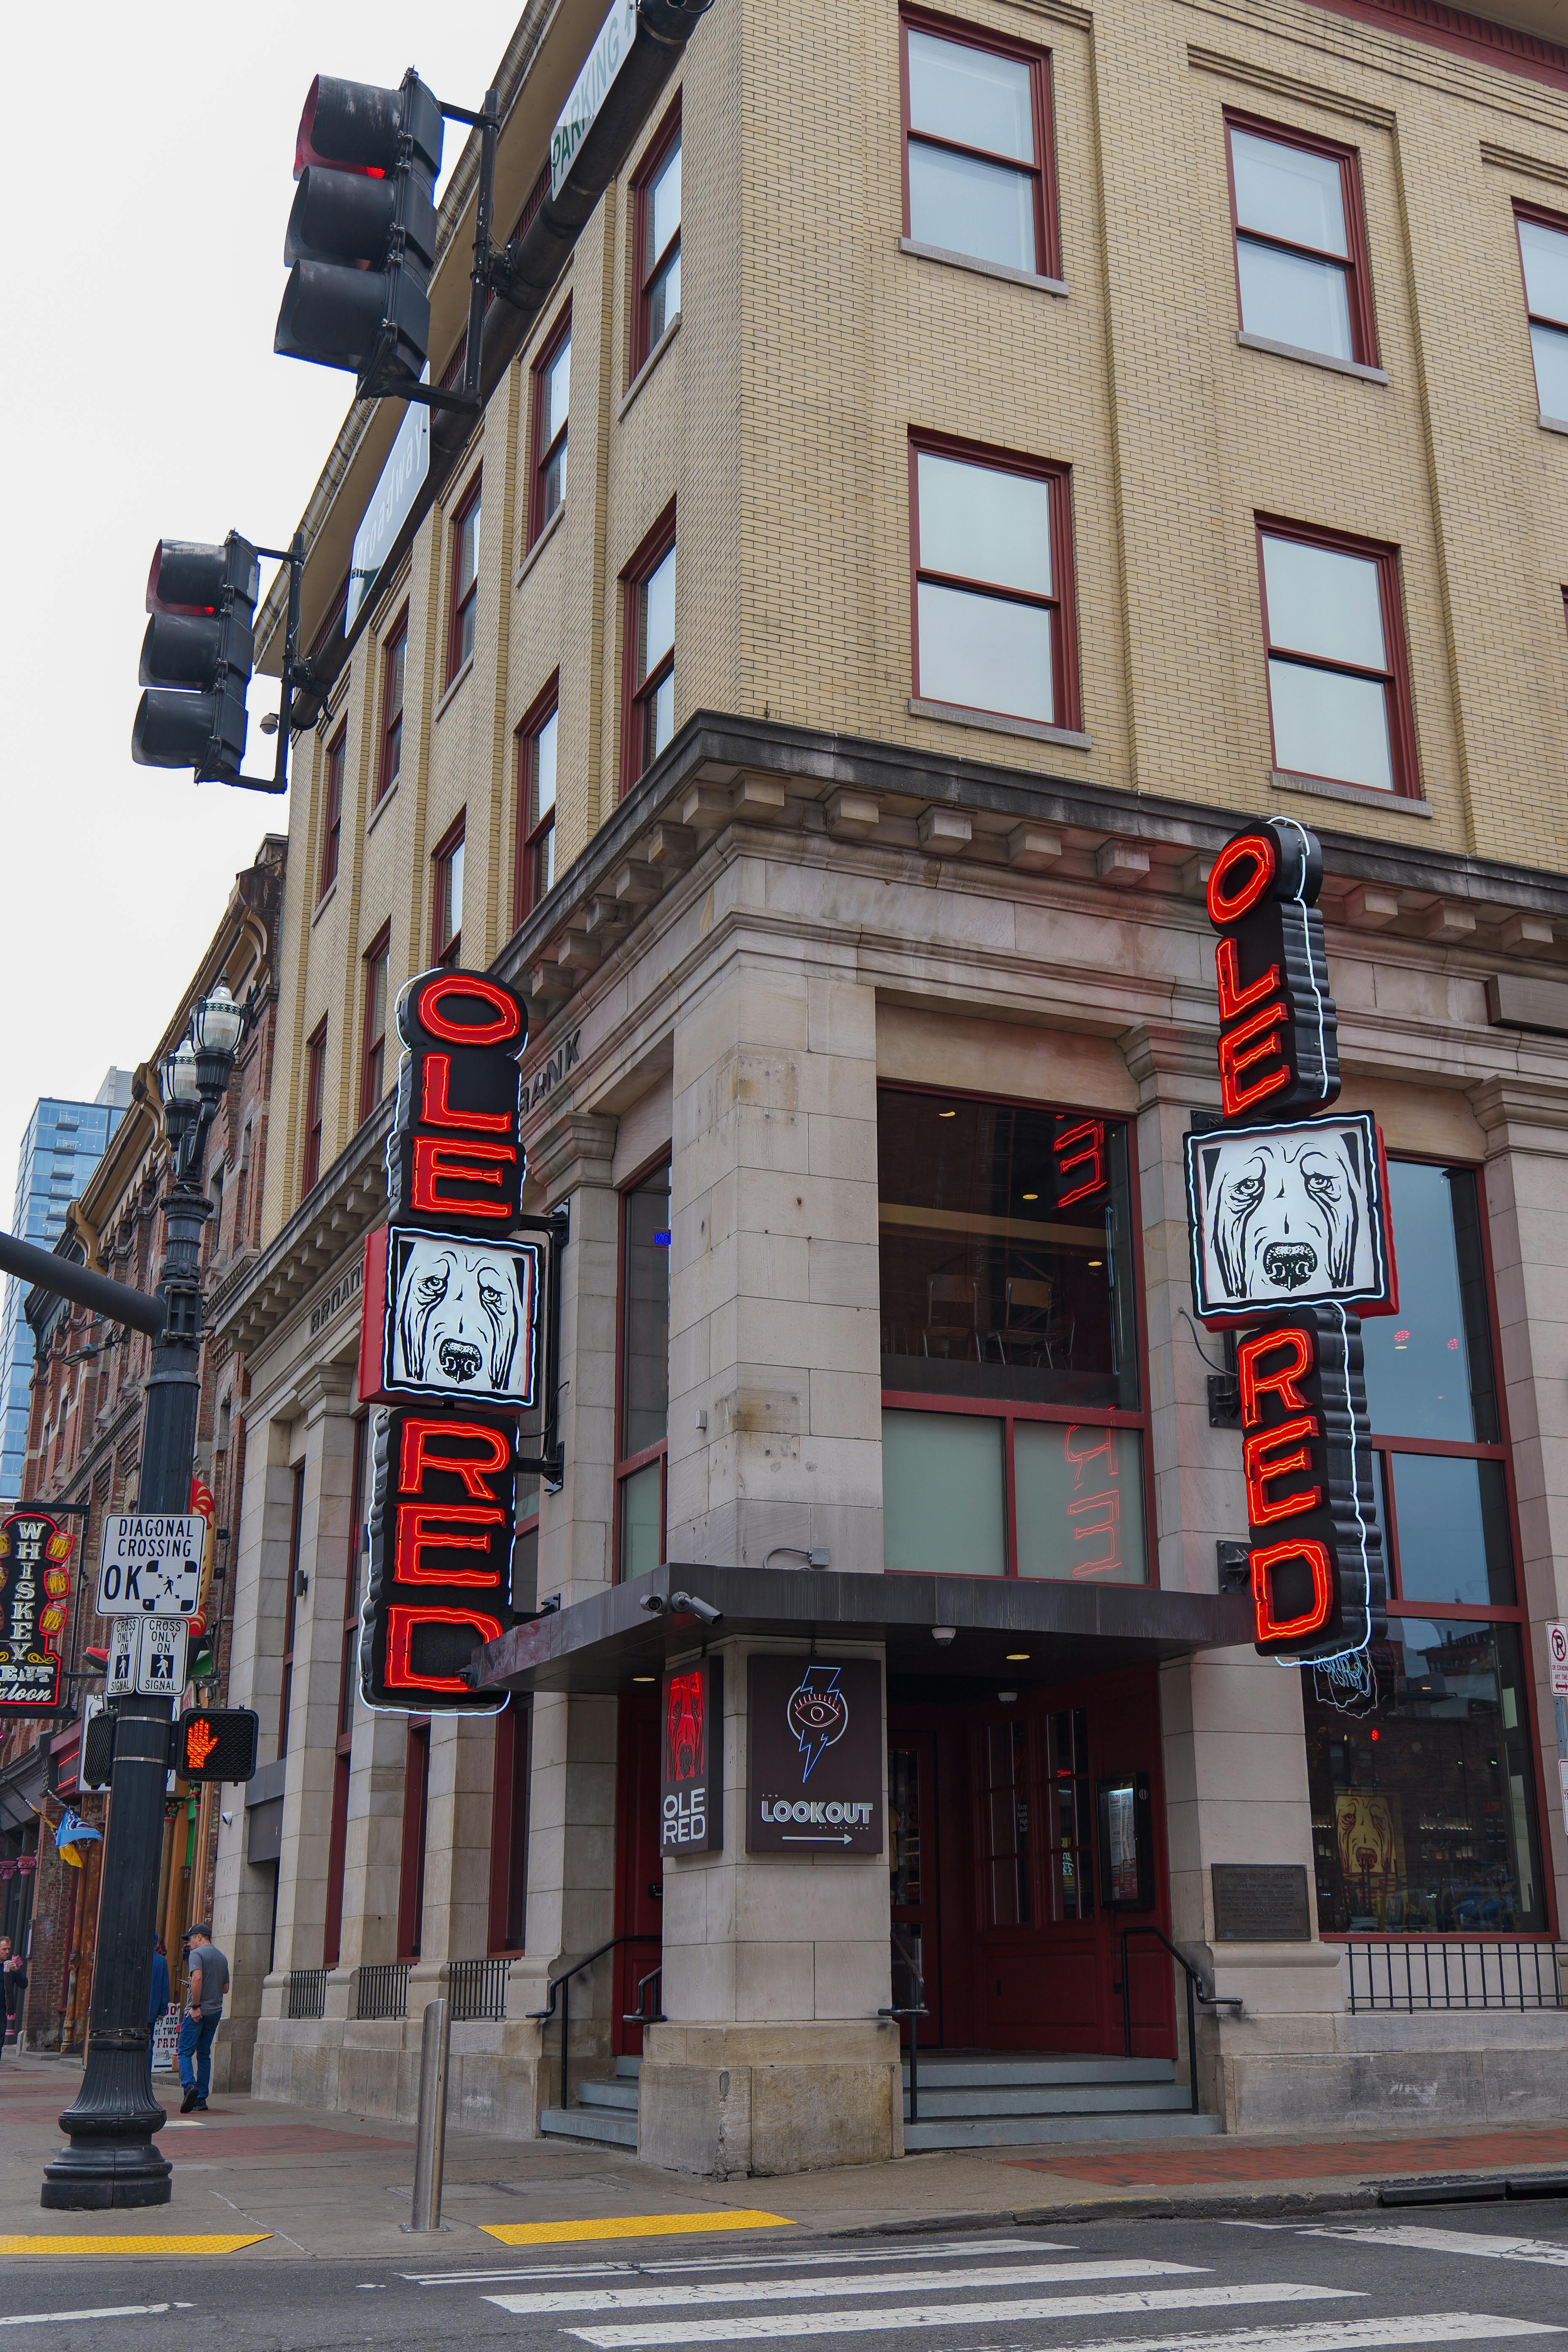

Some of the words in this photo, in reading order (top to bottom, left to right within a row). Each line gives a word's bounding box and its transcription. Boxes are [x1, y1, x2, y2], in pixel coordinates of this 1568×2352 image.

[553, 17, 619, 189] PARKING
[1207, 835, 1289, 1118] OLE
[520, 1030, 581, 1119] BANK
[410, 975, 521, 1218] OLE
[1238, 1328, 1333, 1642] RED
[119, 1519, 193, 1537] DIAGONAL
[49, 1538, 68, 1558] WB
[118, 1539, 191, 1557] CROSSING
[384, 1417, 509, 1693] RED
[9, 1522, 46, 1660] WHISKEY
[49, 1575, 66, 1594] WB
[104, 1565, 143, 1600] OK
[43, 1610, 62, 1630] WB
[117, 1620, 136, 1632] CROSS
[149, 1620, 181, 1631] CROSS
[118, 1631, 133, 1643] ONLY
[152, 1631, 177, 1642] ONLY
[120, 1643, 128, 1653] ON
[157, 1643, 170, 1653] ON
[0, 1665, 54, 1682] ENT
[0, 1682, 51, 1701] aloon
[111, 1680, 129, 1691] SIGNAL
[145, 1680, 176, 1690] SIGNAL
[663, 1788, 705, 1818] OLE
[761, 1800, 873, 1824] LOOKOUT
[663, 1814, 705, 1845] RED
